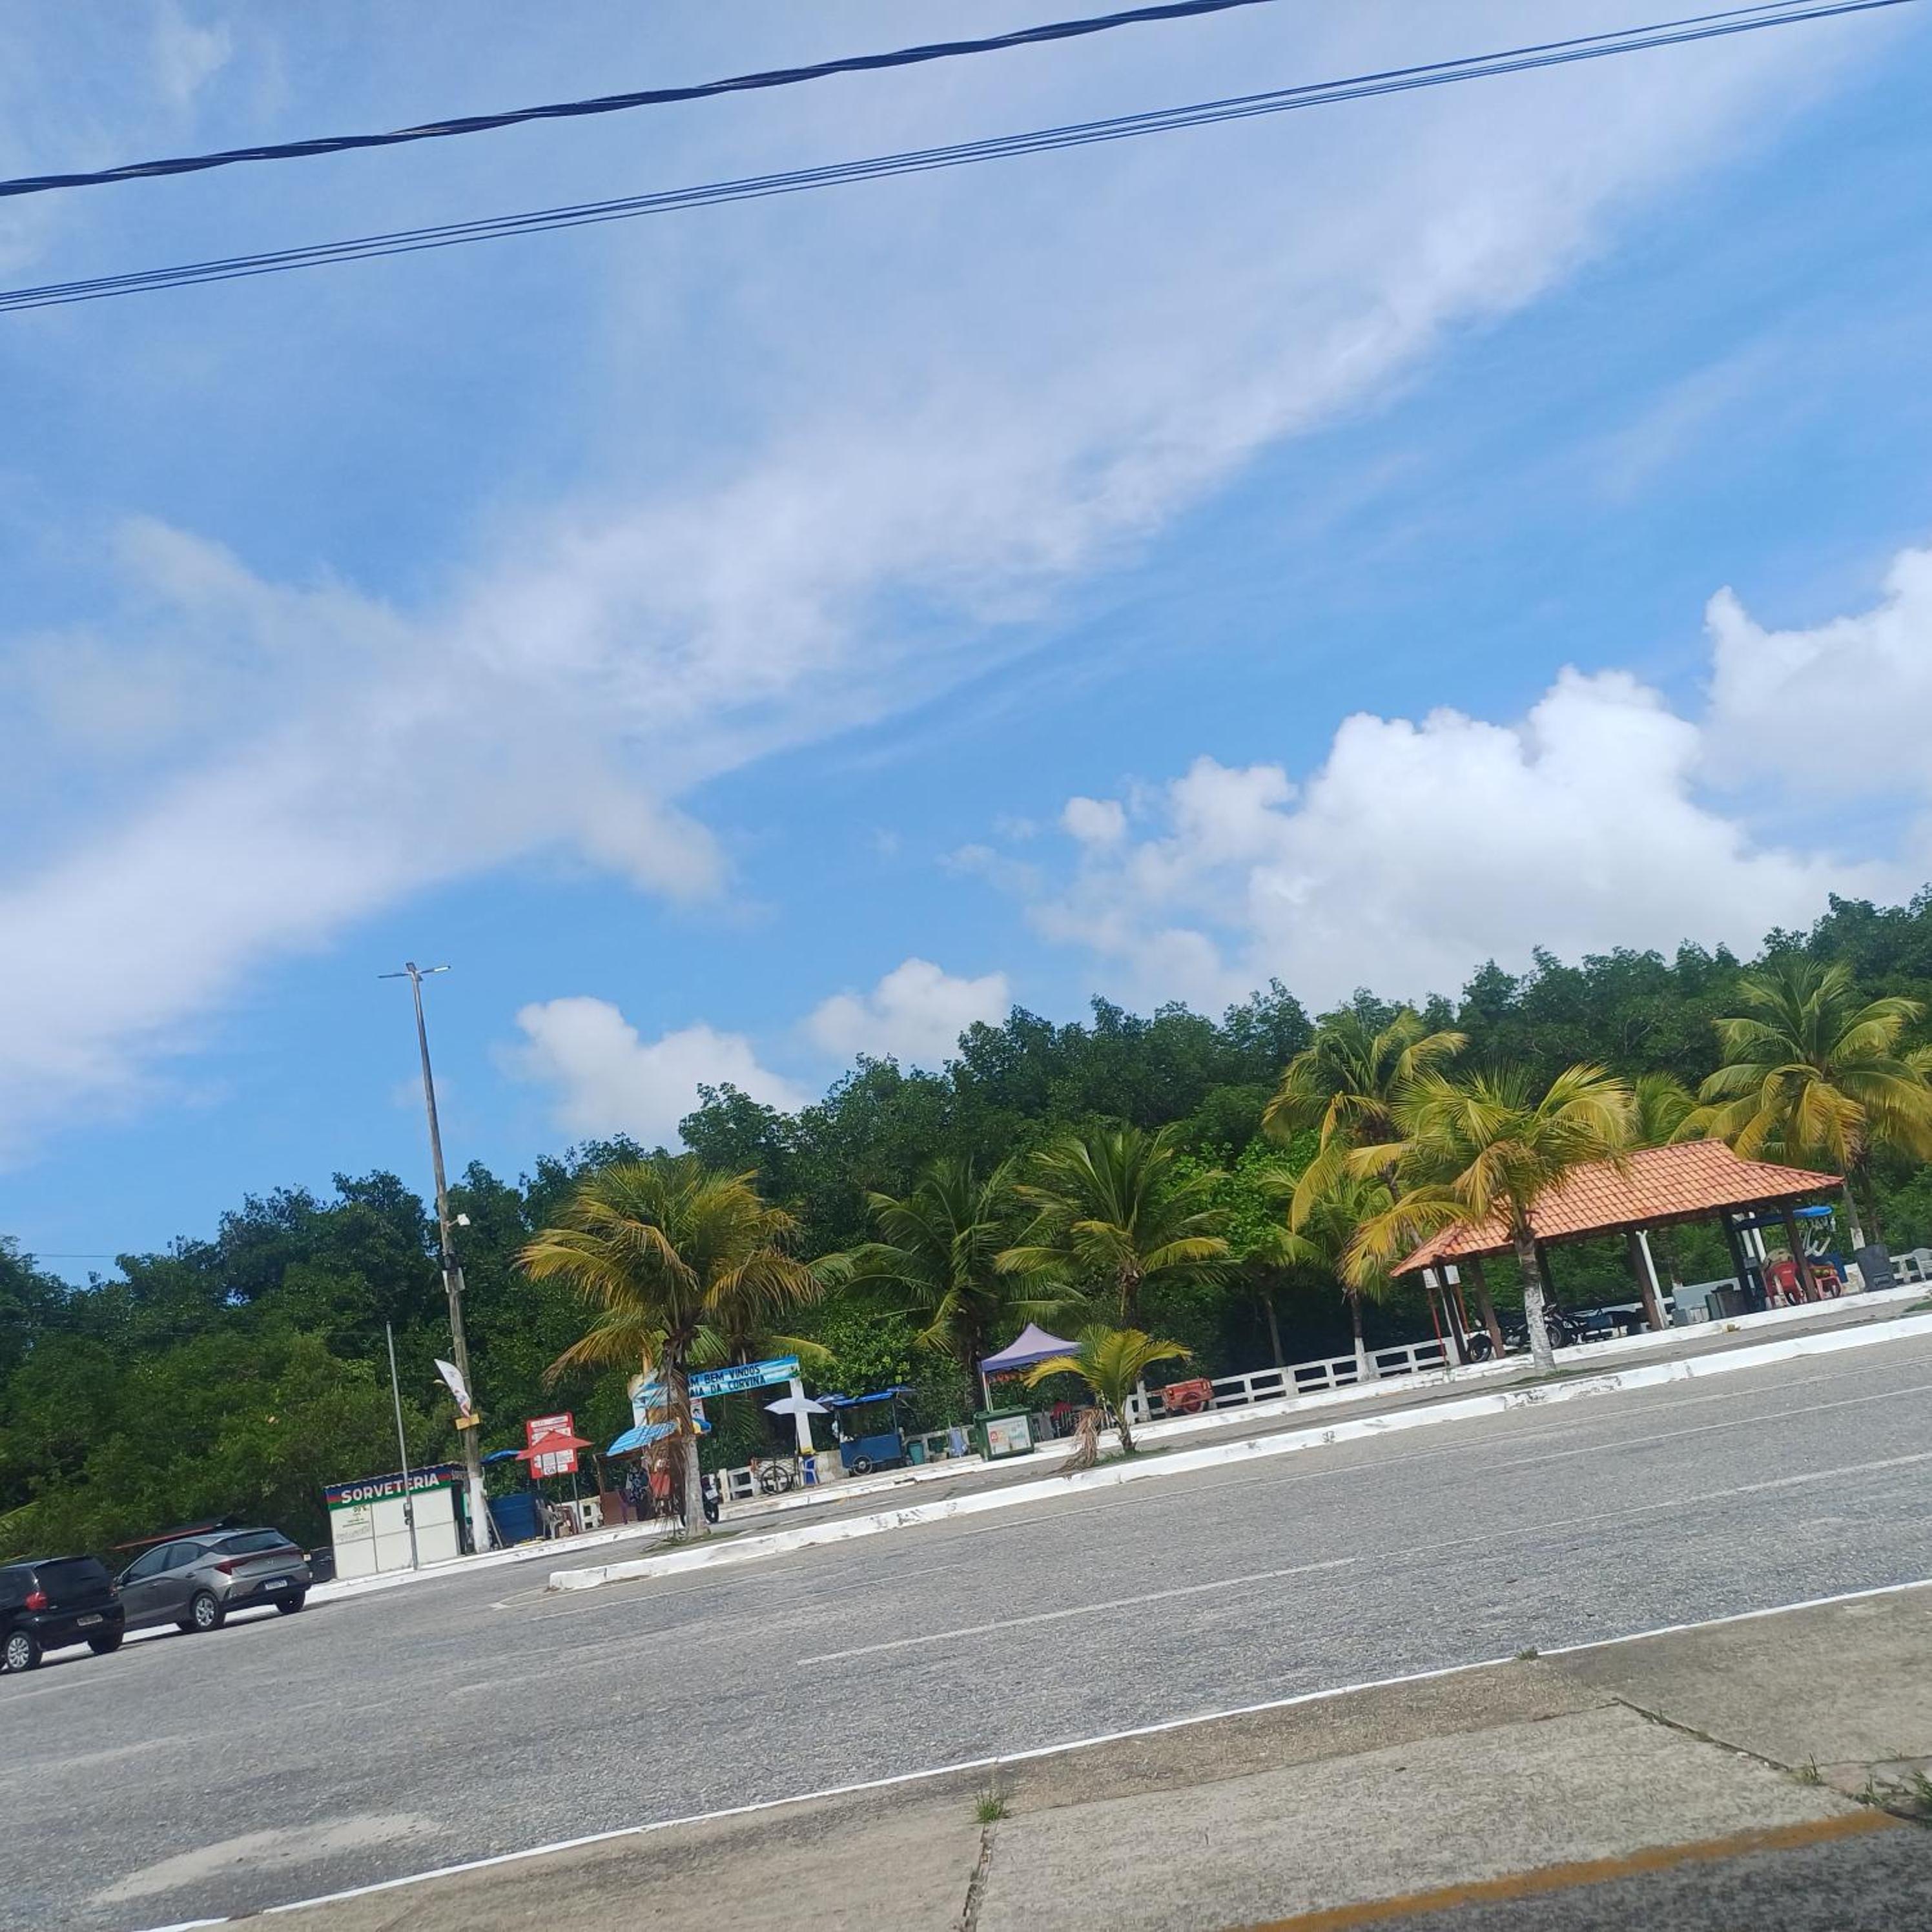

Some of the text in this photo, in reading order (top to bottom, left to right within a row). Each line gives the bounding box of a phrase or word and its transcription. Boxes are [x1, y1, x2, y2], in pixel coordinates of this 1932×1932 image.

[704, 1371, 724, 1384] BEM
[728, 1364, 761, 1380] VINDOS
[710, 1383, 723, 1395] DA
[728, 1374, 766, 1390] CORVINA
[340, 1472, 440, 1504] SORVETERIA
